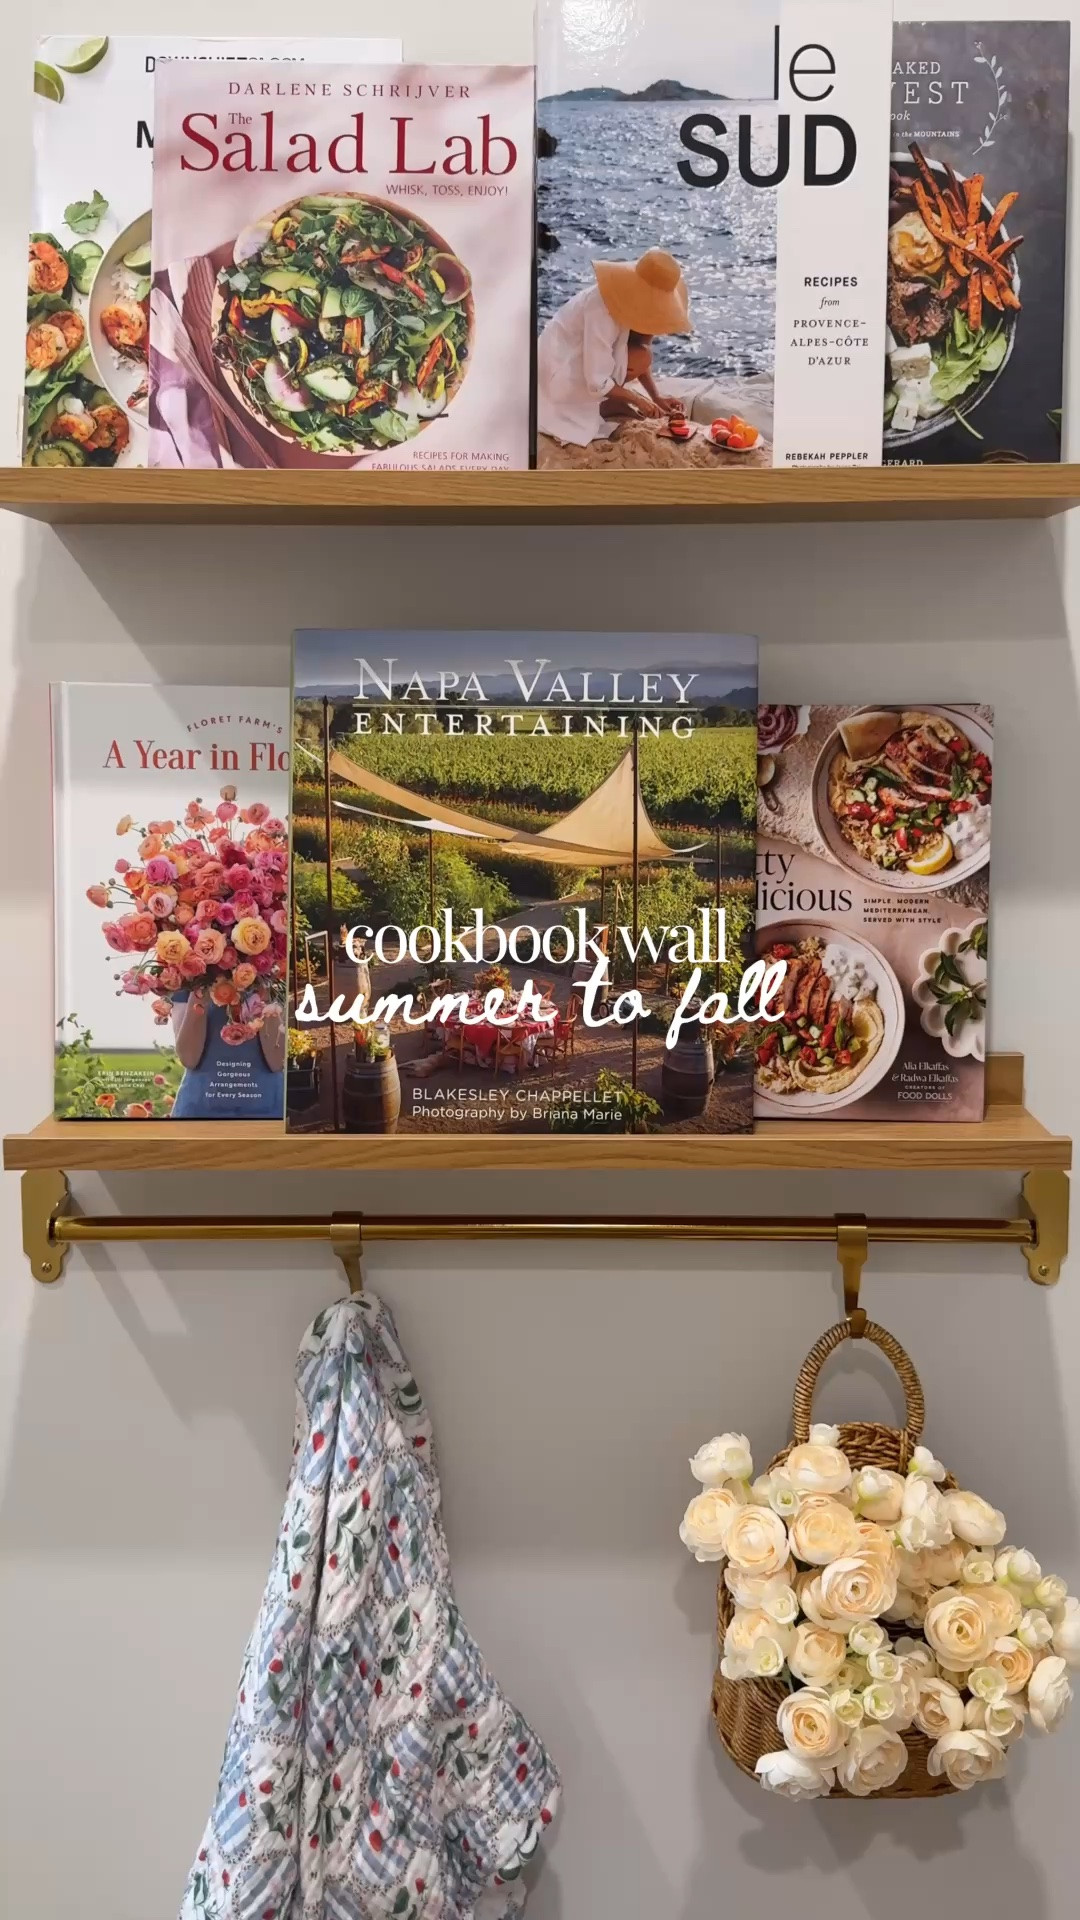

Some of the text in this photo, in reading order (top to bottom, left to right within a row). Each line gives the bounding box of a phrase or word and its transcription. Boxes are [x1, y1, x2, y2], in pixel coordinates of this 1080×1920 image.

[774, 24, 836, 101] le
[892, 61, 941, 75] AKED
[228, 81, 472, 99] DARLENE SCHRIJVER
[891, 81, 969, 105] EST
[228, 112, 252, 125] The
[180, 110, 518, 176] Salad Lab
[676, 113, 857, 189] SUD
[386, 184, 508, 197] WHISK, TOSS, ENJOY!
[804, 276, 858, 287] RECIPES
[819, 296, 840, 309] from
[793, 319, 866, 328] PROVENCE-
[790, 335, 869, 347] ALPES-CÔTE
[808, 356, 851, 365] D'AZUR
[413, 451, 510, 462] RECIPES FOR MAKING
[829, 452, 868, 460] PEPPLER
[186, 715, 283, 735] FLORET FARM'S
[353, 712, 696, 739] ENTERTAINING
[102, 739, 126, 769] A
[133, 740, 202, 770] Year
[210, 743, 240, 771] in
[216, 1060, 252, 1068] Designing
[217, 1071, 251, 1079] Gorgeous
[209, 1081, 258, 1089] Arrangements
[412, 1087, 623, 1103] BLAKESLEY CHAPPELLET
[897, 1091, 953, 1101] FOOD DOLLS
[412, 1105, 623, 1121] Photography by Briana Marie
